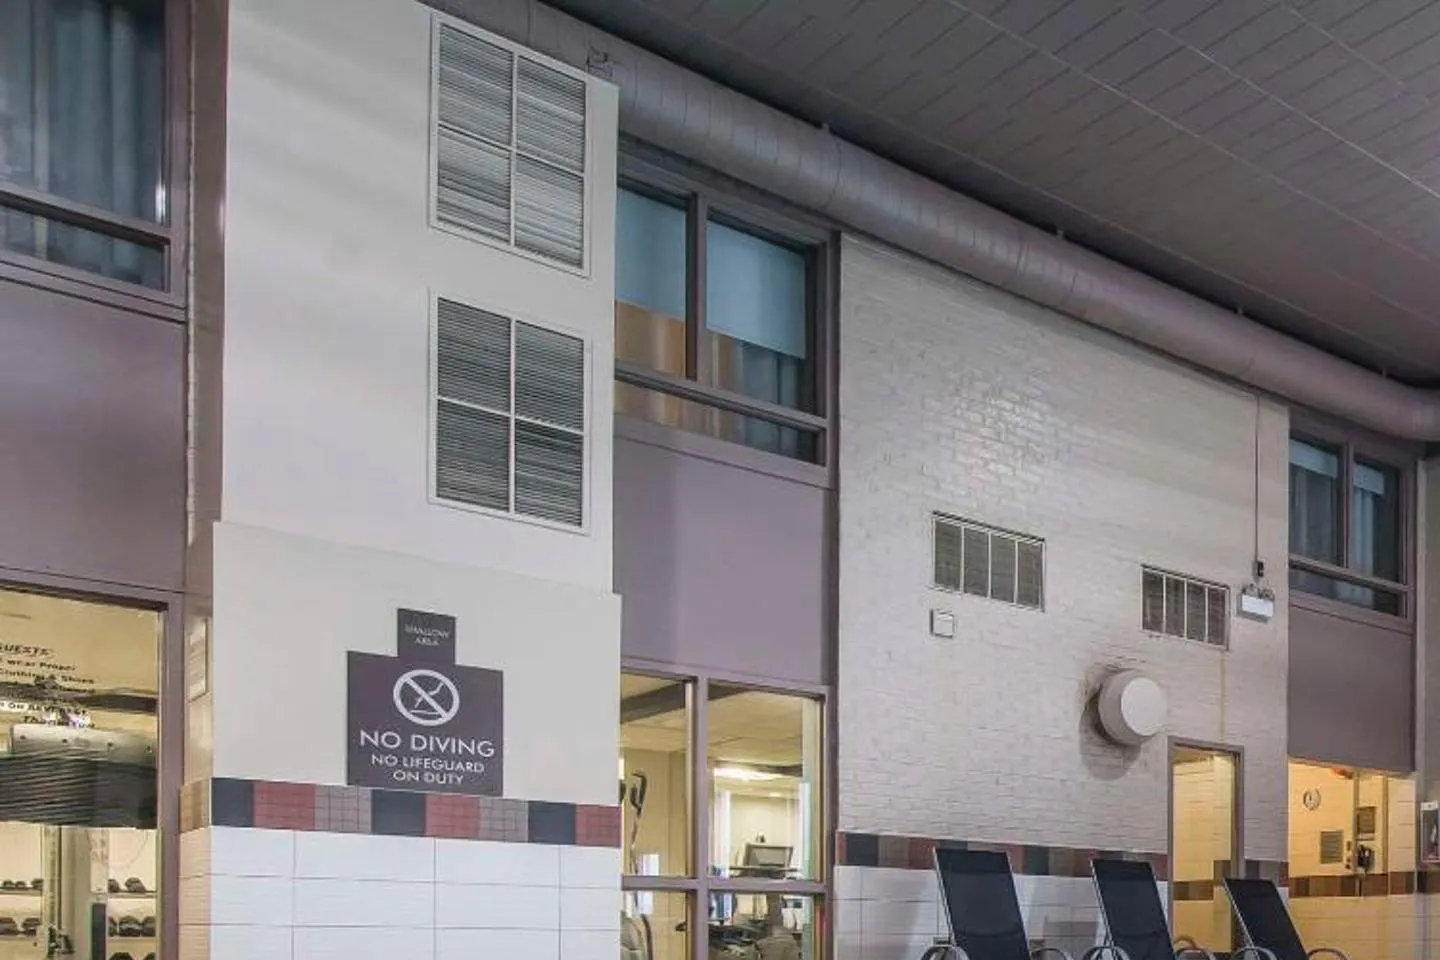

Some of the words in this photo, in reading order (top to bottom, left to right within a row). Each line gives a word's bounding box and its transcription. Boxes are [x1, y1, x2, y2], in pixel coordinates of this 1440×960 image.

[360, 729, 402, 749] NO
[410, 734, 495, 758] DIVING
[371, 754, 399, 768] NO
[402, 757, 485, 774] LIFEGUARD
[393, 769, 420, 783] ON
[423, 772, 464, 785] DUTY
